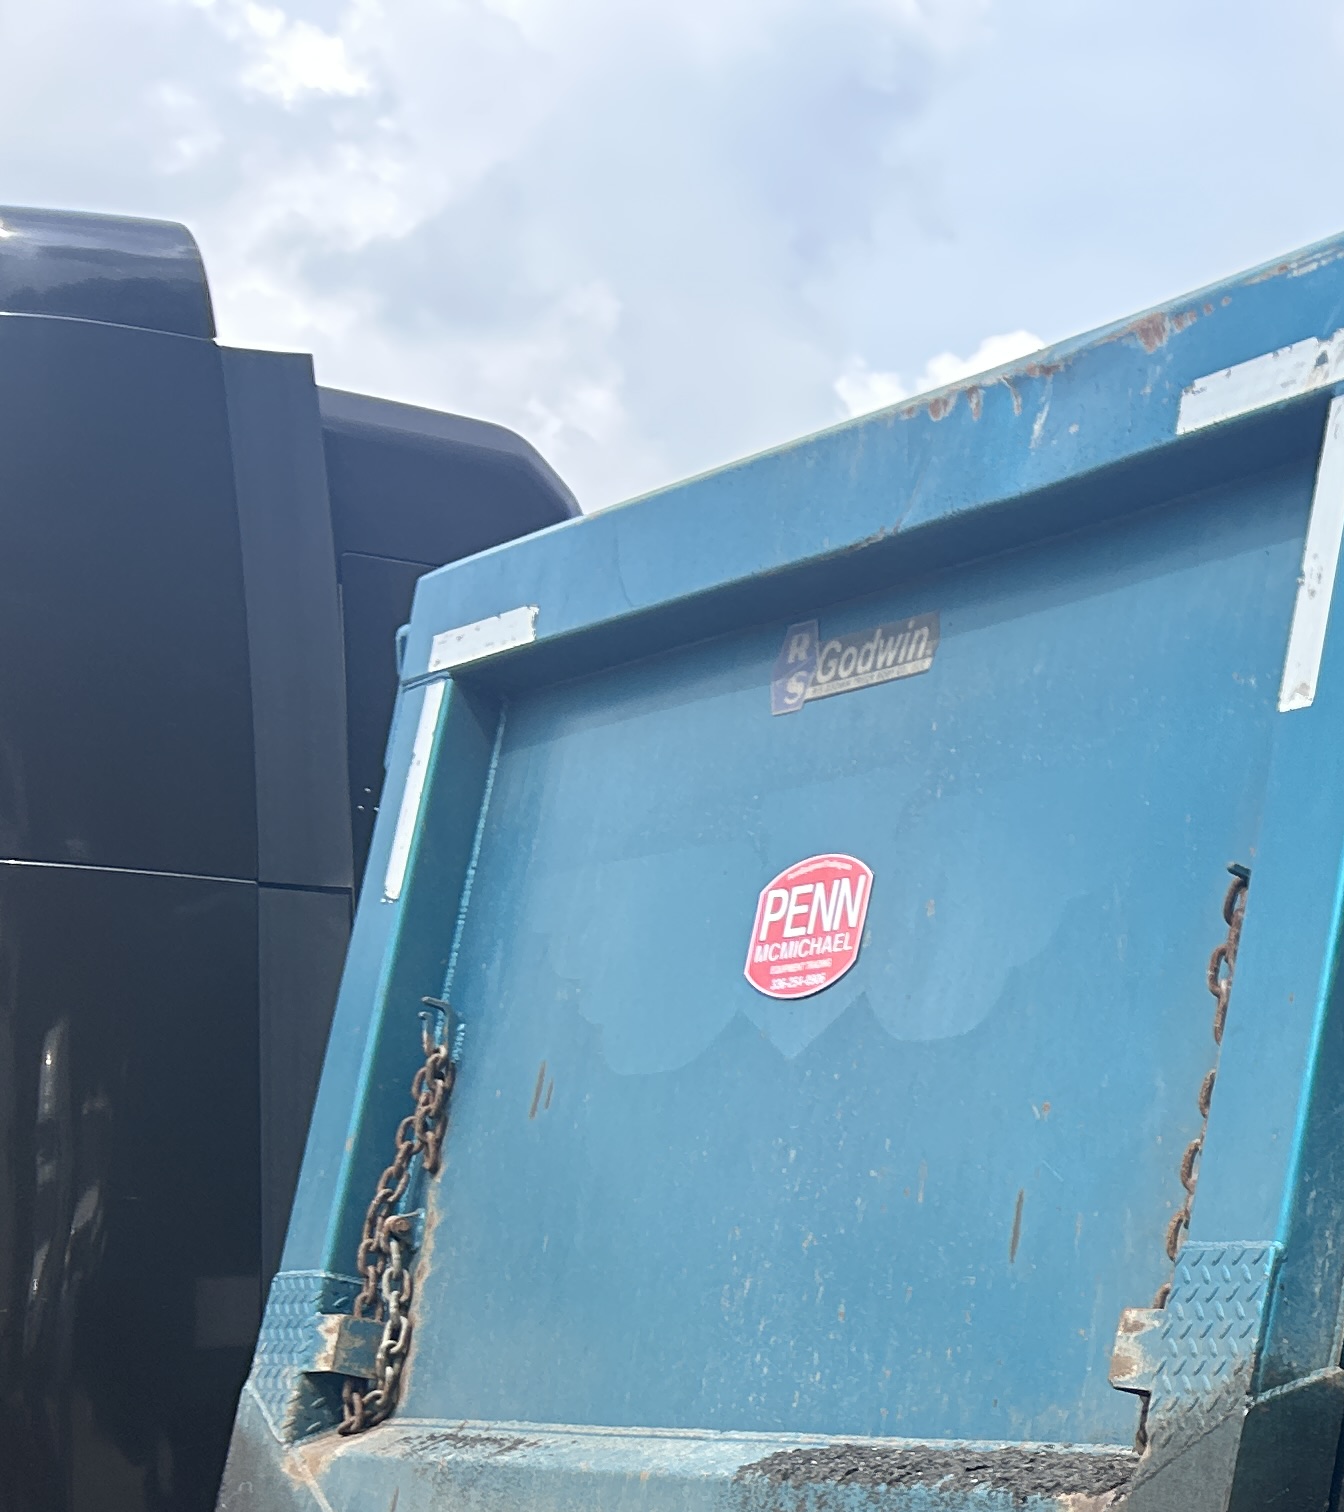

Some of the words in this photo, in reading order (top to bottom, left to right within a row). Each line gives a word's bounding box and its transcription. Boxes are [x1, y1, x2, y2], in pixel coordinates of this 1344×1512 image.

[816, 620, 930, 683] Godwin
[758, 874, 866, 942] PENN
[753, 932, 853, 963] MCMICHAEL
